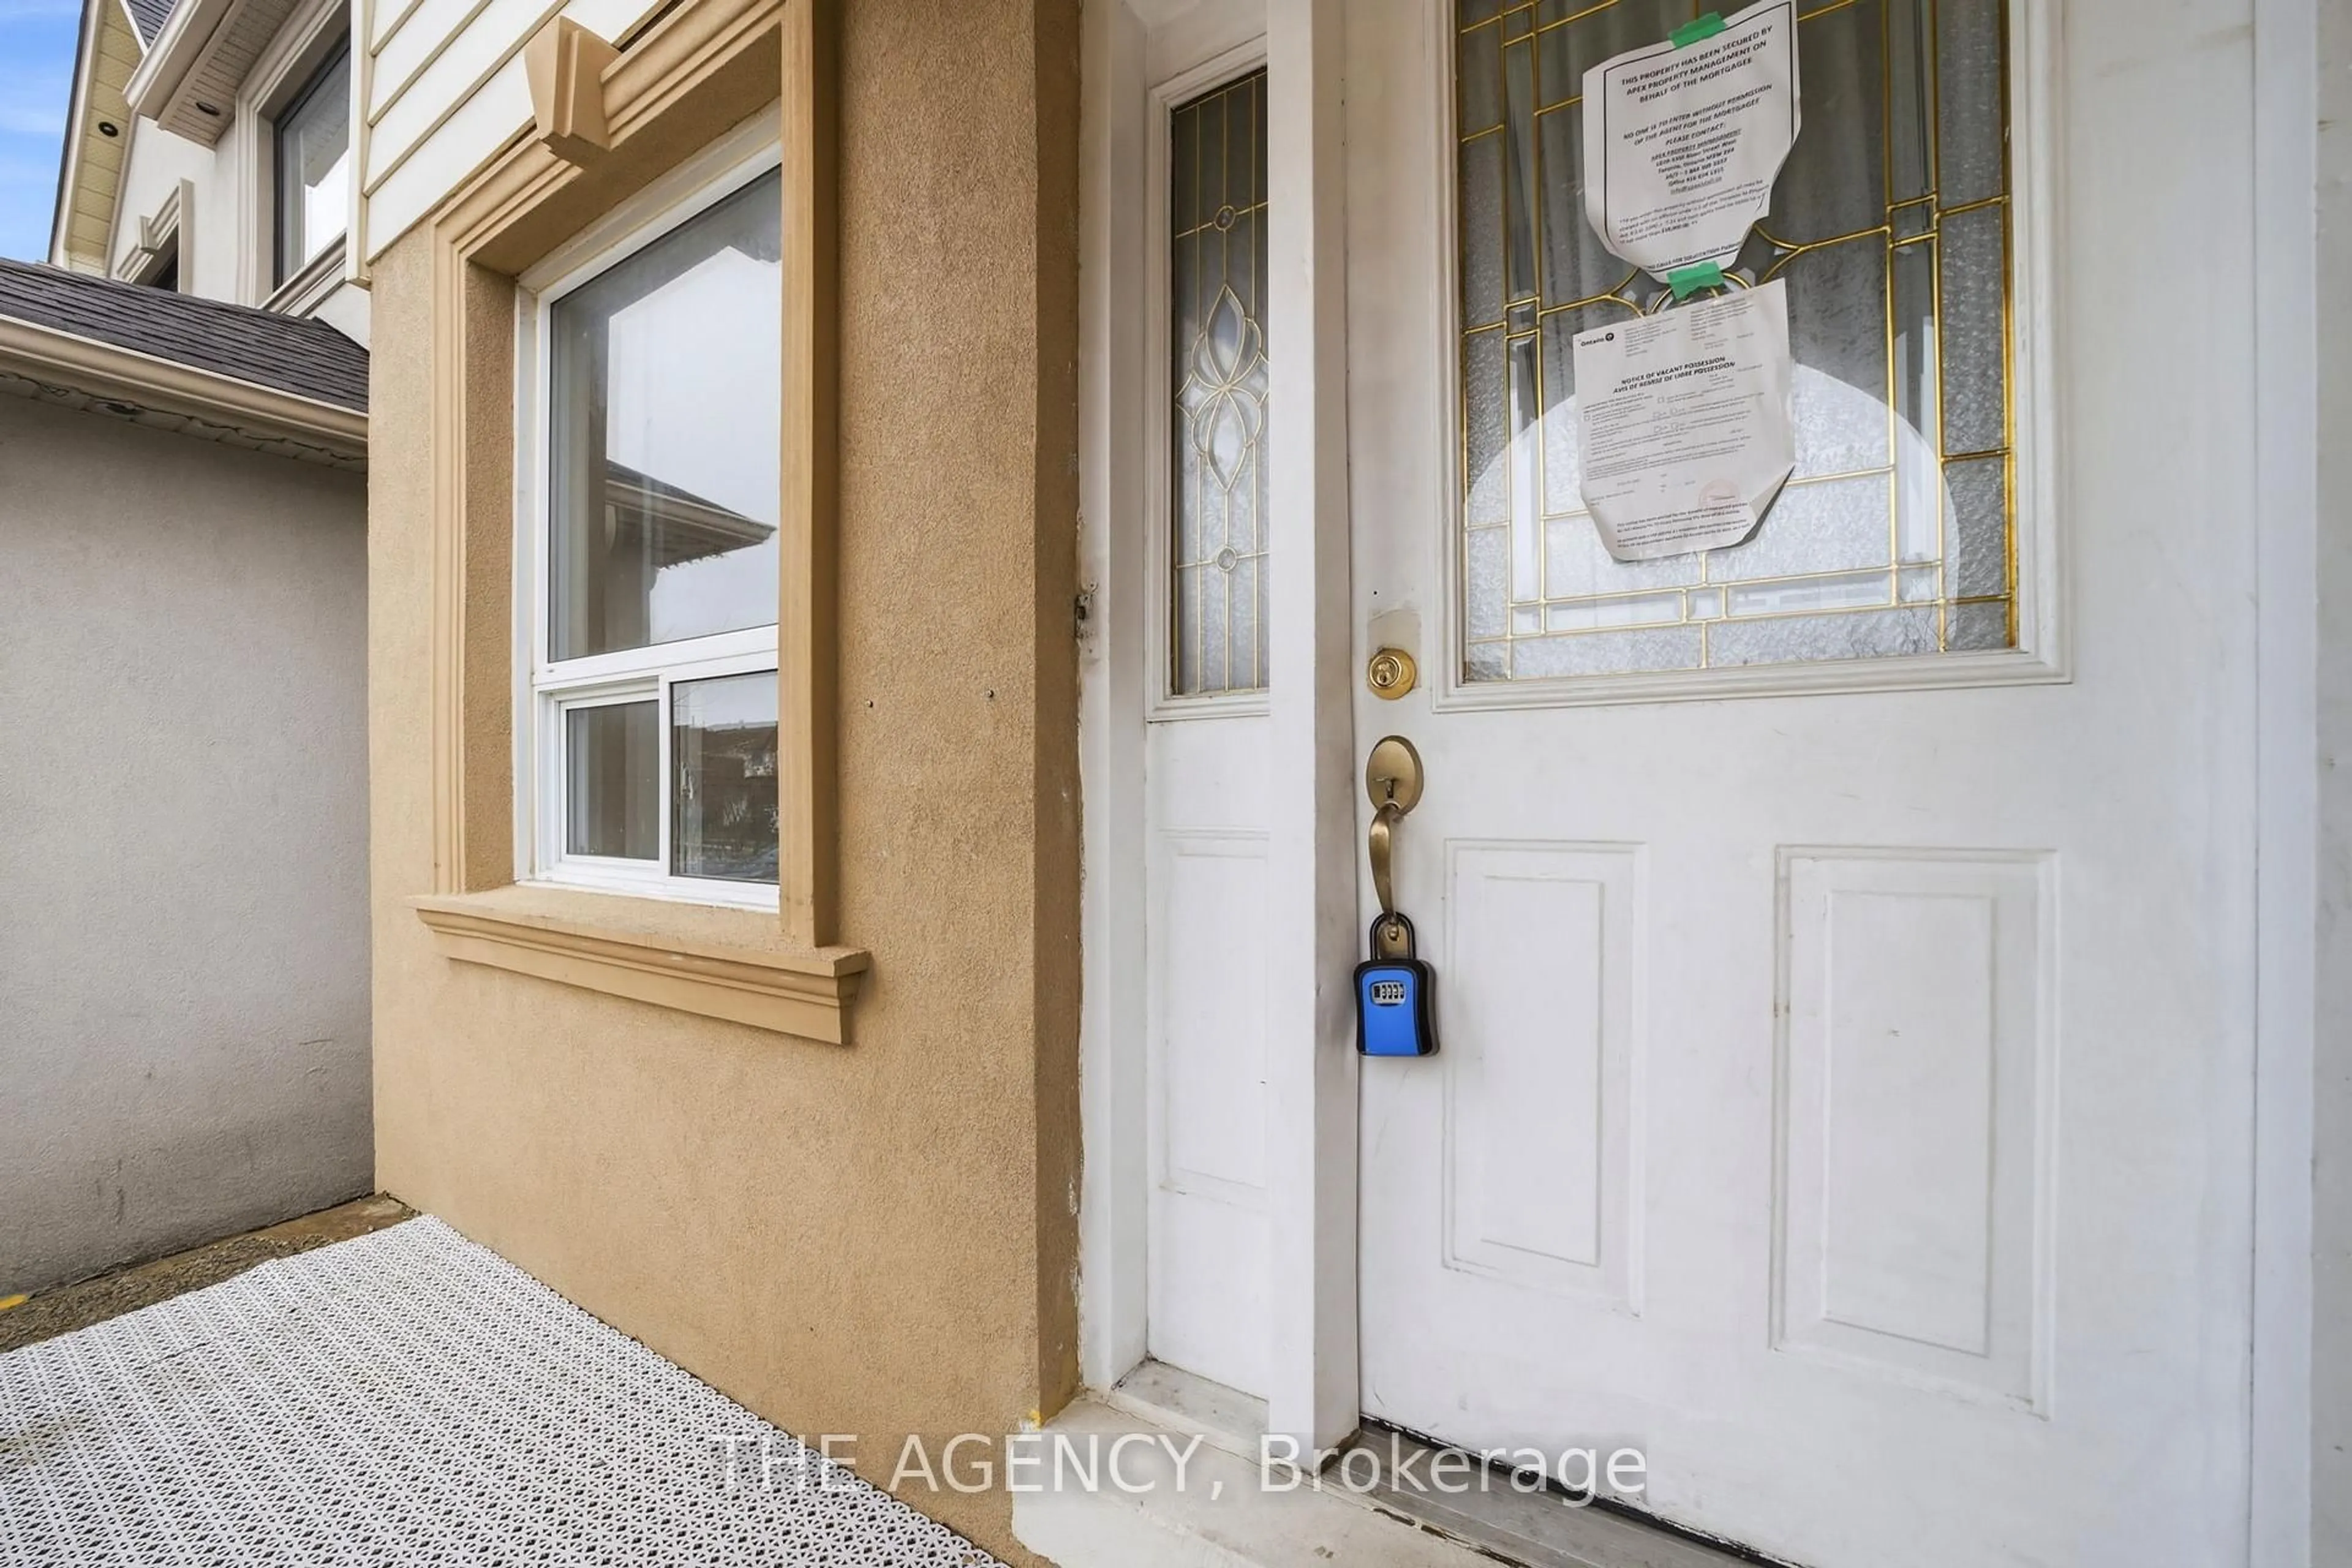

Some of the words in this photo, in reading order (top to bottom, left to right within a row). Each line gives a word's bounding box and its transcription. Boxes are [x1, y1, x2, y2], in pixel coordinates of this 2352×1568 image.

[1622, 76, 1638, 86] THIS
[1640, 62, 1679, 81] PROPERTY
[1681, 57, 1698, 67] HAS
[1699, 49, 1721, 61] BEEN
[1722, 31, 1759, 52] SECURED
[1761, 25, 1773, 36] BY
[1627, 84, 1646, 96] APEX
[1648, 70, 1688, 89] PROPERTY
[1690, 48, 1751, 74] MANAGEMENT
[1753, 40, 1766, 51] ON
[1640, 89, 1667, 103] BEHALF
[1684, 78, 1697, 89] THE
[1700, 56, 1752, 83] MORTGAGEE
[1659, 124, 1683, 137] AGENT
[1714, 97, 1760, 118] MORTGAGEE
[1669, 113, 1691, 123] ENTER
[1692, 100, 1725, 117] WITHOUT
[1727, 83, 1773, 105] PERMISSION
[1665, 134, 1690, 145] PLEASE
[1580, 337, 1604, 347] Ontario
[1613, 385, 1628, 394] AVIS
[1675, 370, 1692, 380] LIBRE
[1694, 362, 1735, 375] POSSESSION
[1621, 375, 1645, 385] NOTICE
[1656, 365, 1683, 377] VACANT
[1684, 356, 1726, 369] POSSESSION
